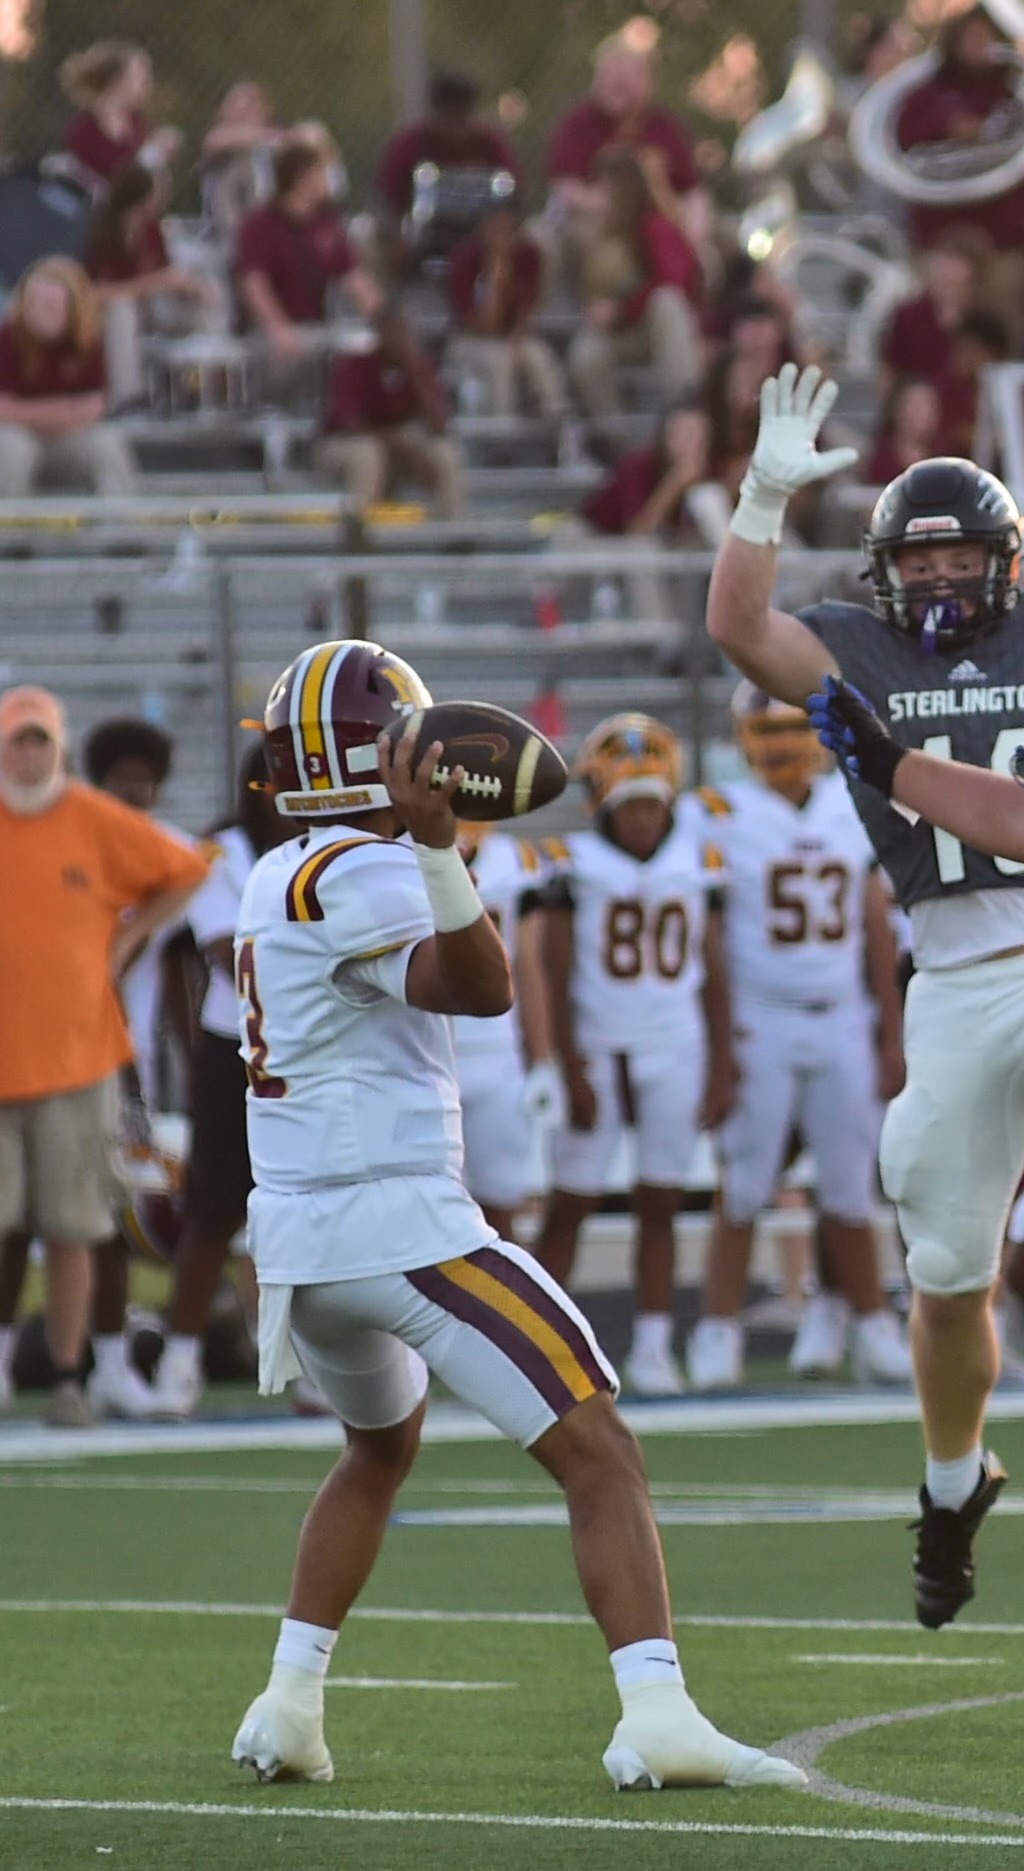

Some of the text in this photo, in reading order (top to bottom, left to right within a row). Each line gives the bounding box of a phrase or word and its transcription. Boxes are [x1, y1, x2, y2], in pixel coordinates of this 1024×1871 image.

[309, 756, 321, 773] 3
[607, 900, 688, 980] 80
[769, 863, 847, 944] 53
